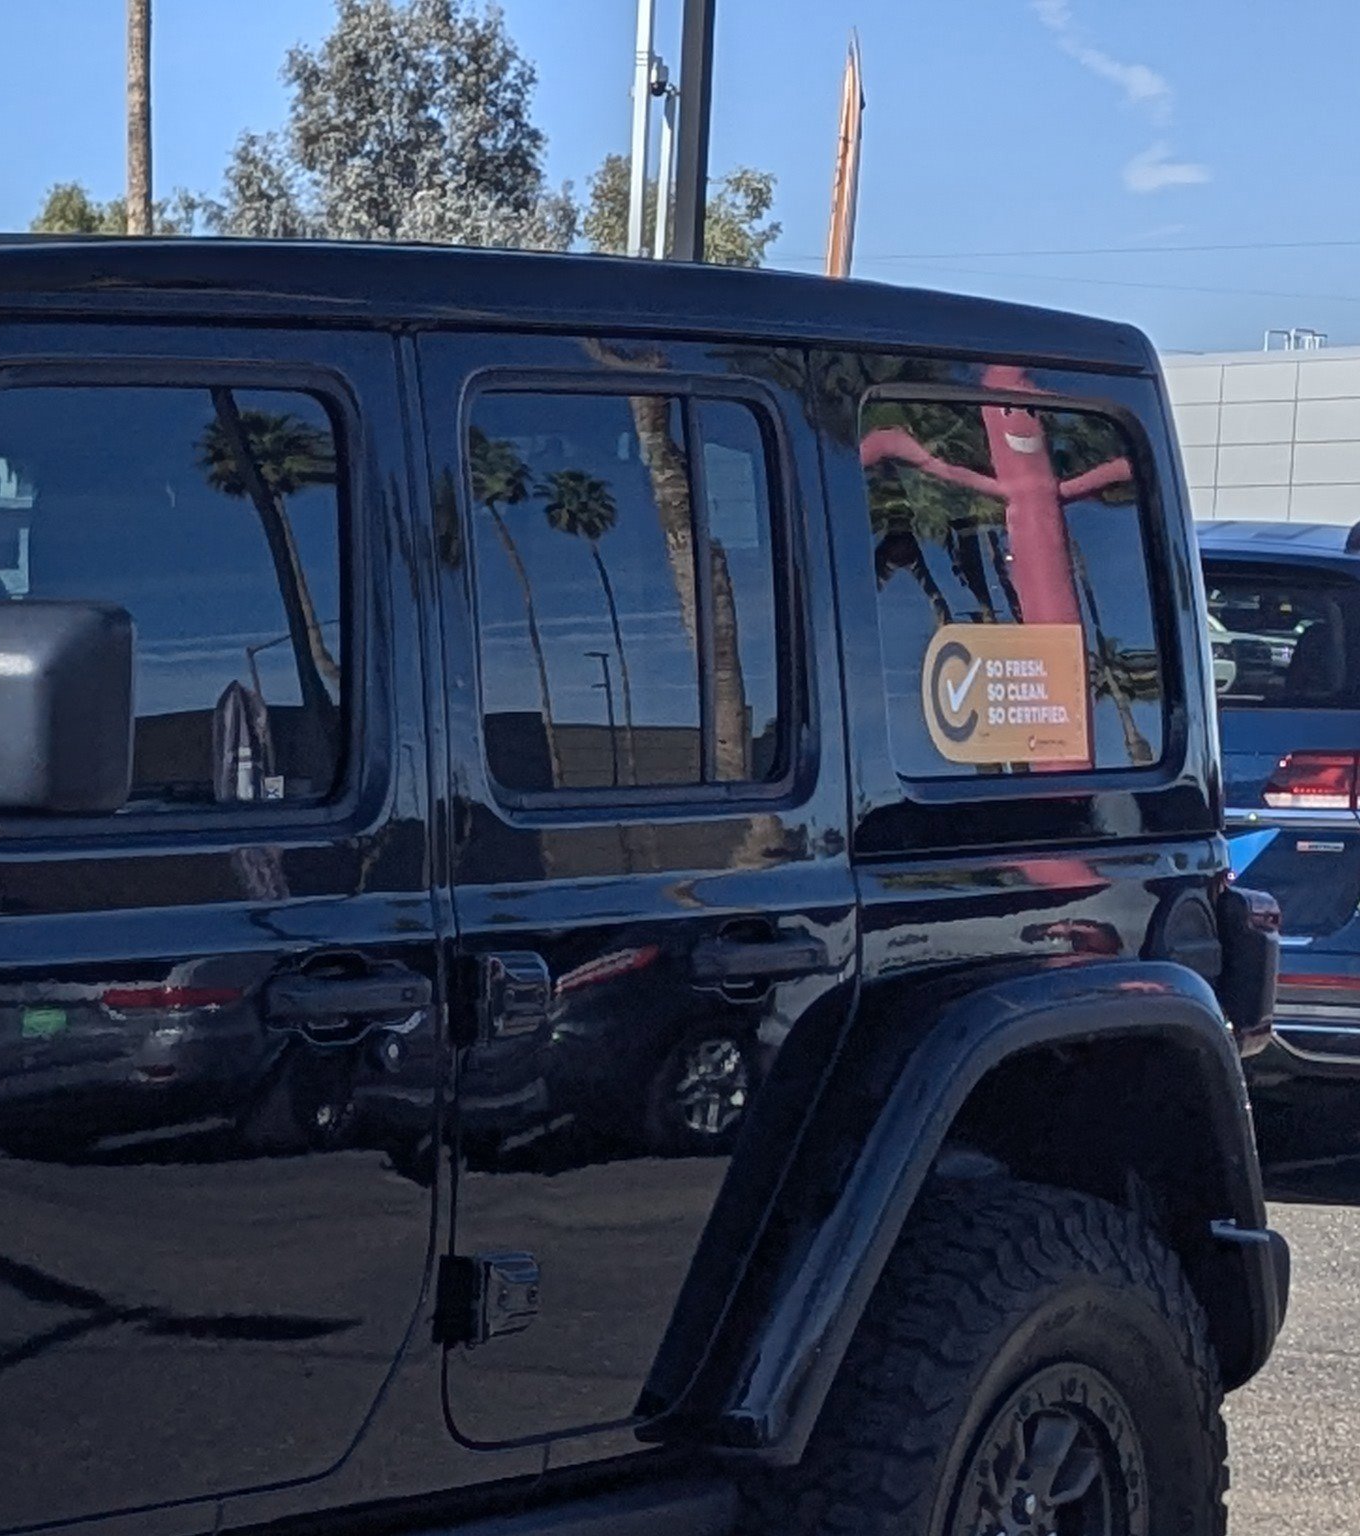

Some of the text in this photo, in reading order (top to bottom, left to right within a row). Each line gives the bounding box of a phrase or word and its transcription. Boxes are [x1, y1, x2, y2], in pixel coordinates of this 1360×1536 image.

[985, 660, 1048, 677] SO FRESH.
[987, 683, 1049, 701] SO CLEAN.
[988, 706, 1070, 724] SO CERTIFIED.
